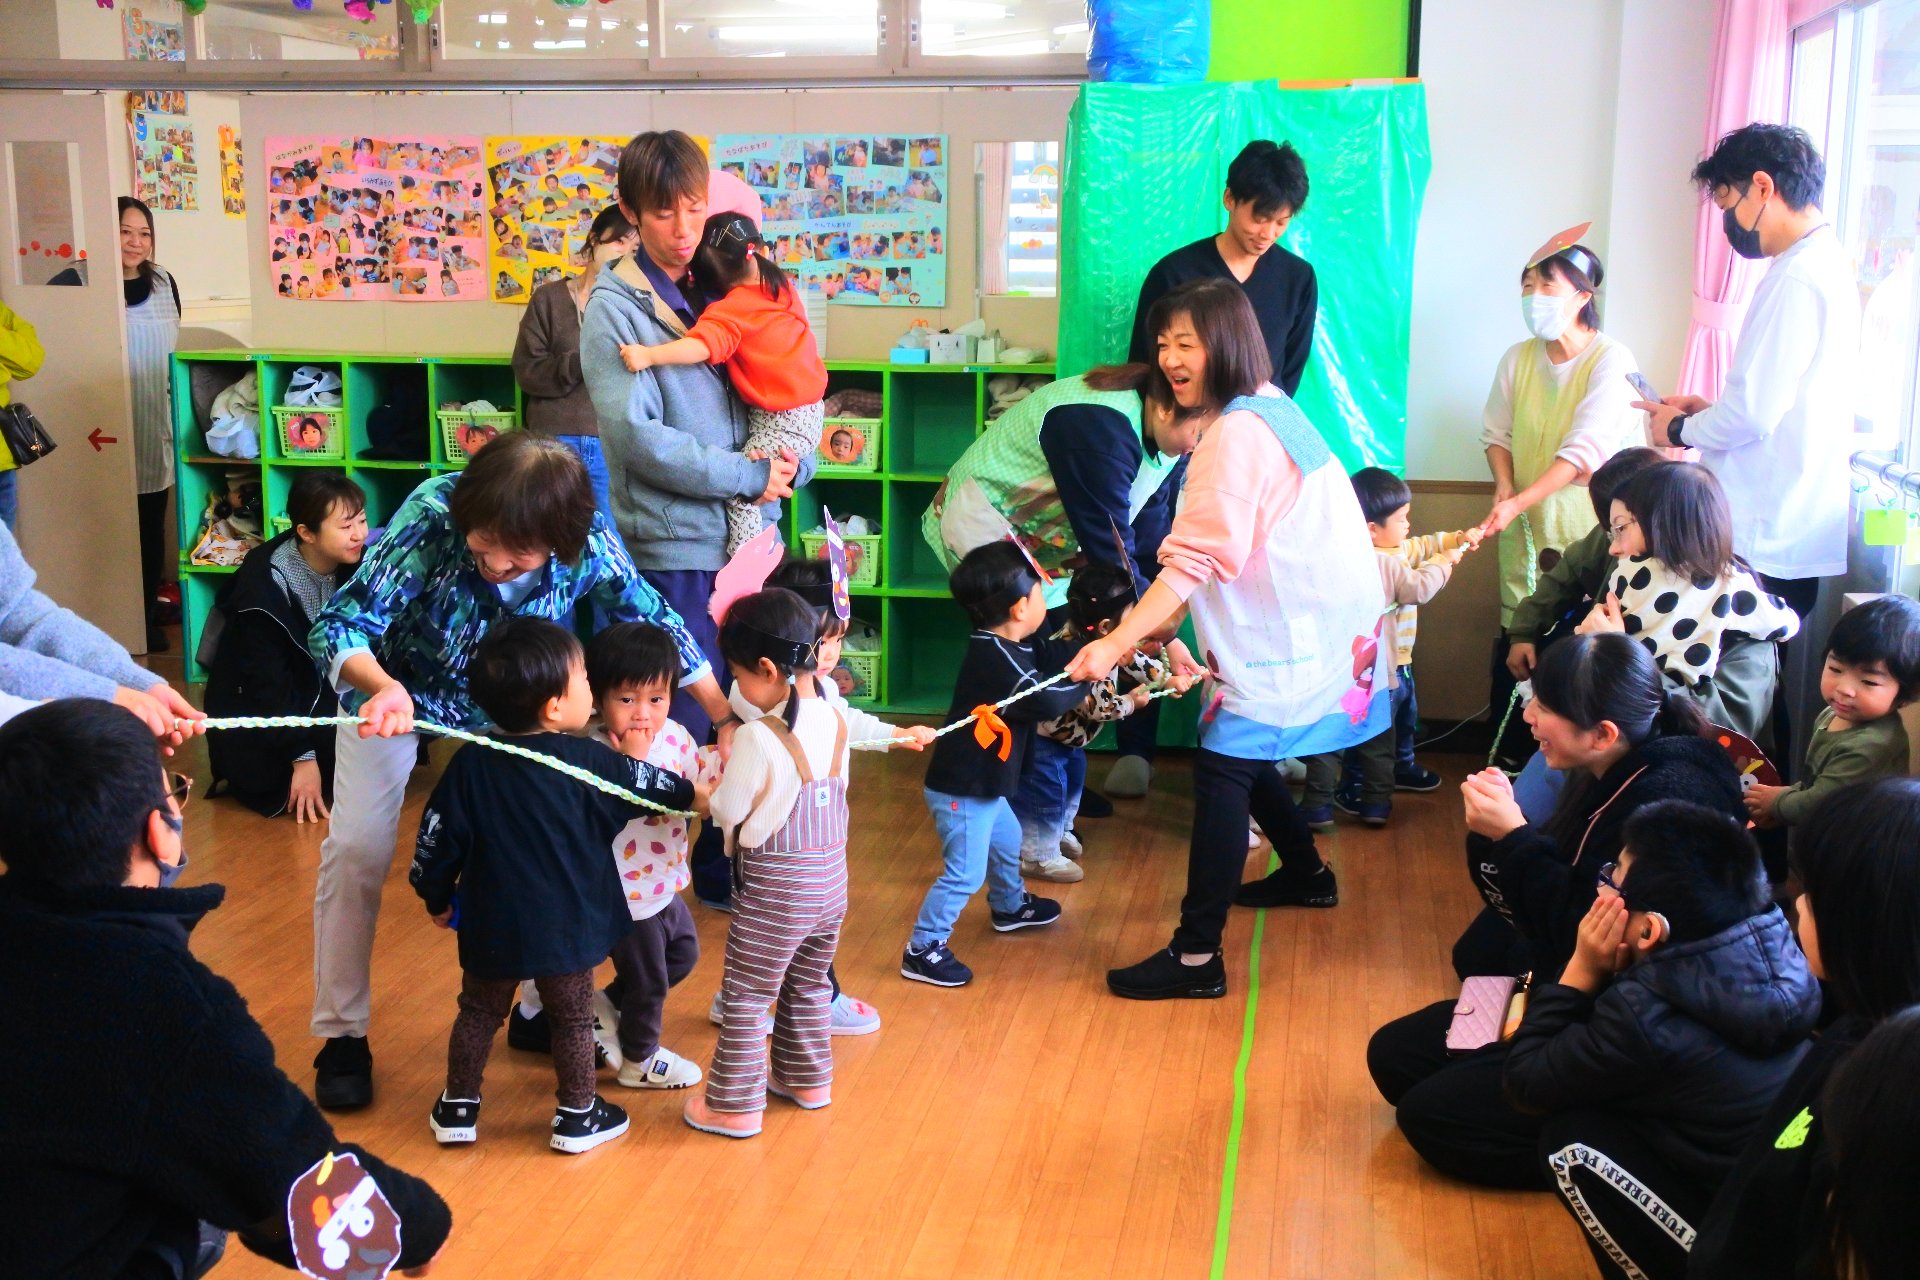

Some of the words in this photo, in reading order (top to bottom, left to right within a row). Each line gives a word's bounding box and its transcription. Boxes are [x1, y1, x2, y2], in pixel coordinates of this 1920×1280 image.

[275, 143, 314, 161] はながみあそび
